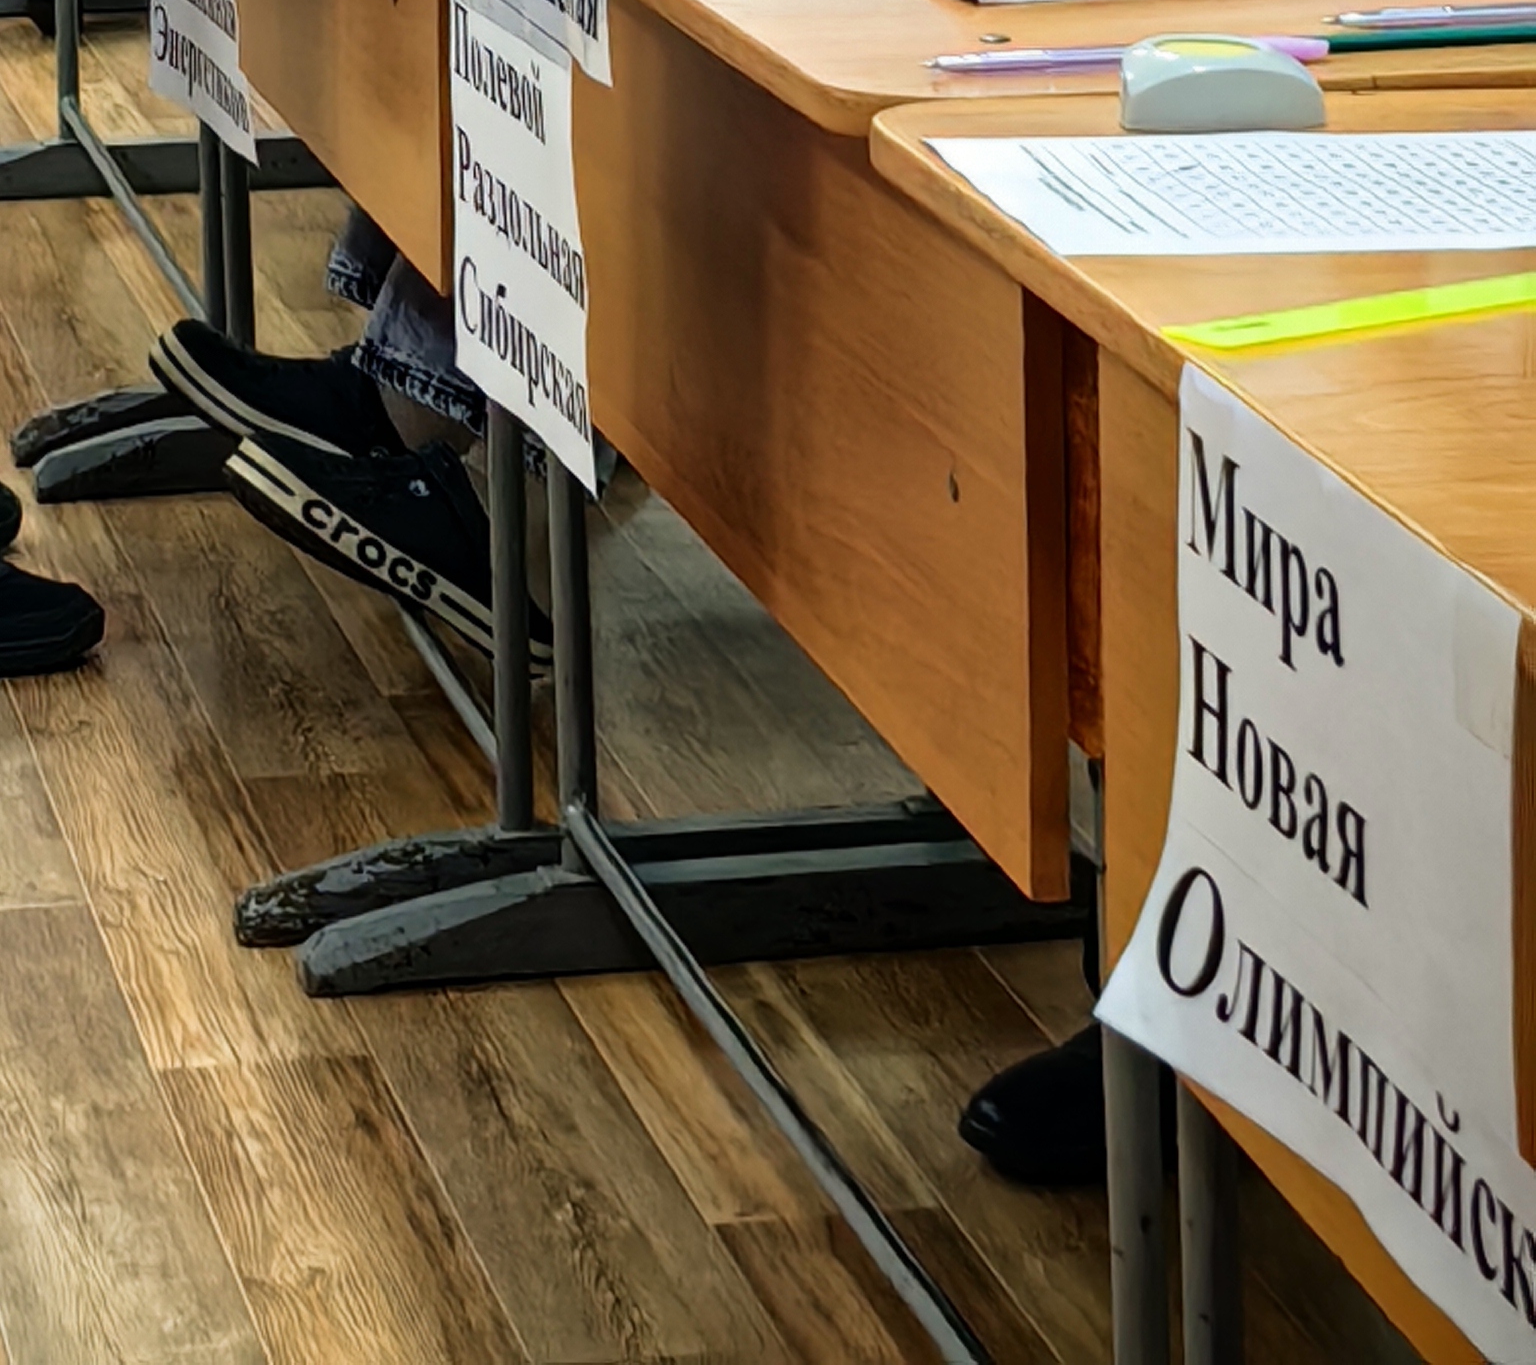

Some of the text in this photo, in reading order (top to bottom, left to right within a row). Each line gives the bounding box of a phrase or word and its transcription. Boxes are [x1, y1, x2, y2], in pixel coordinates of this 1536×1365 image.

[453, 1, 547, 146] Полевой
[455, 125, 586, 313] Раздольная
[458, 254, 591, 444] Сибирская
[301, 498, 437, 602] crocs
[1184, 425, 1346, 671] Мира
[1187, 634, 1371, 911] Новая
